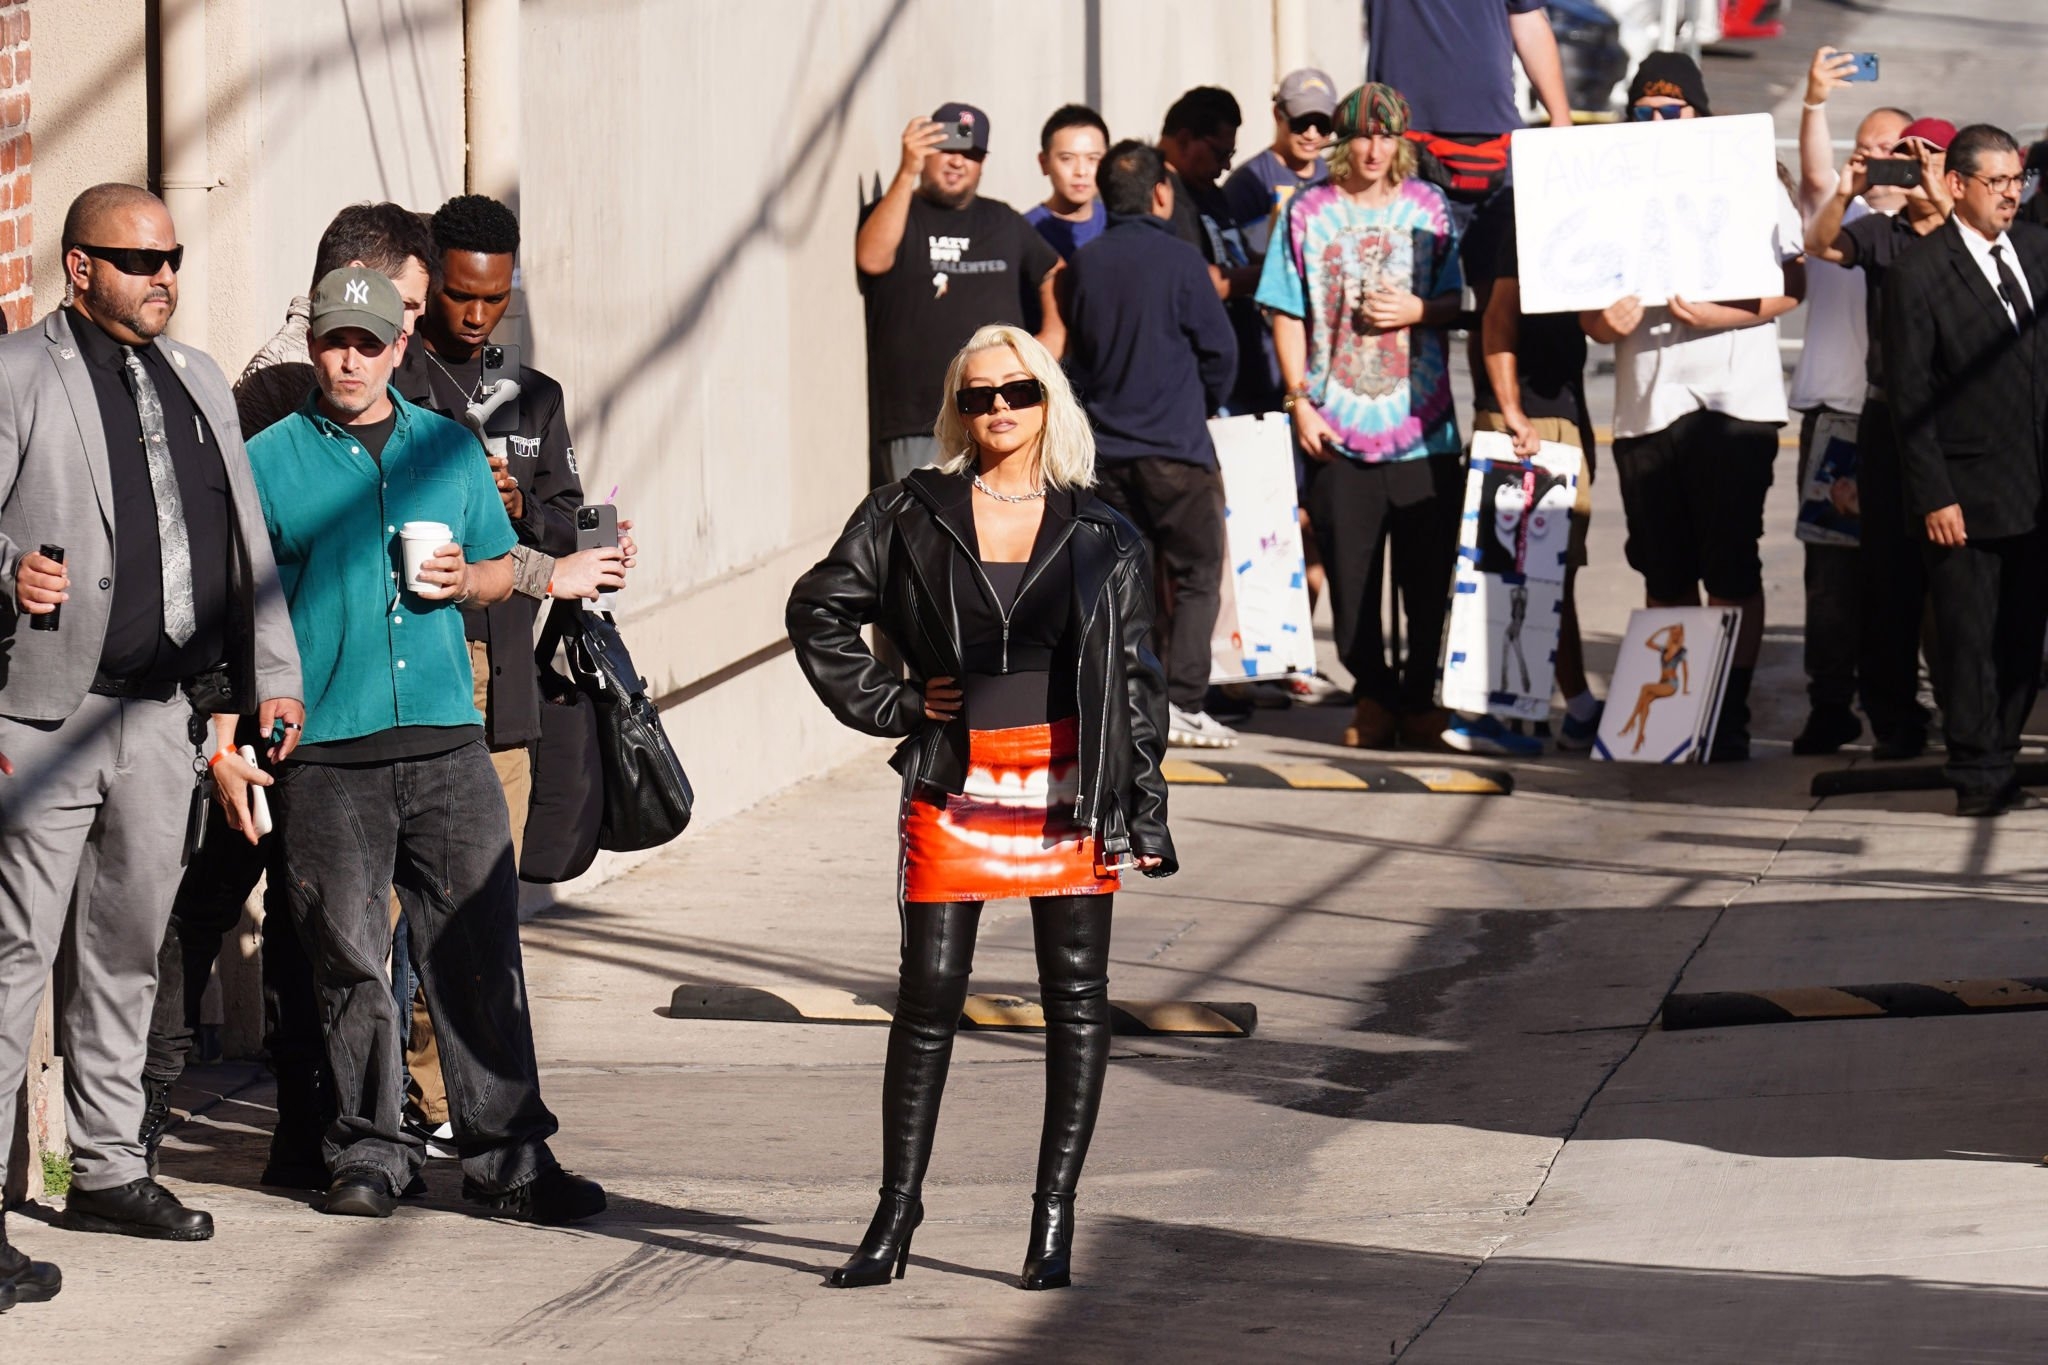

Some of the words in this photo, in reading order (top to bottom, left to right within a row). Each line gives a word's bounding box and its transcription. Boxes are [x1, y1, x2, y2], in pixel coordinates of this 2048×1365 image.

[1542, 138, 1686, 199] ANGEL
[929, 236, 970, 250] LAZY
[1538, 192, 1731, 295] GAY
[930, 260, 1006, 272] TALENTED
[343, 278, 370, 304] NY
